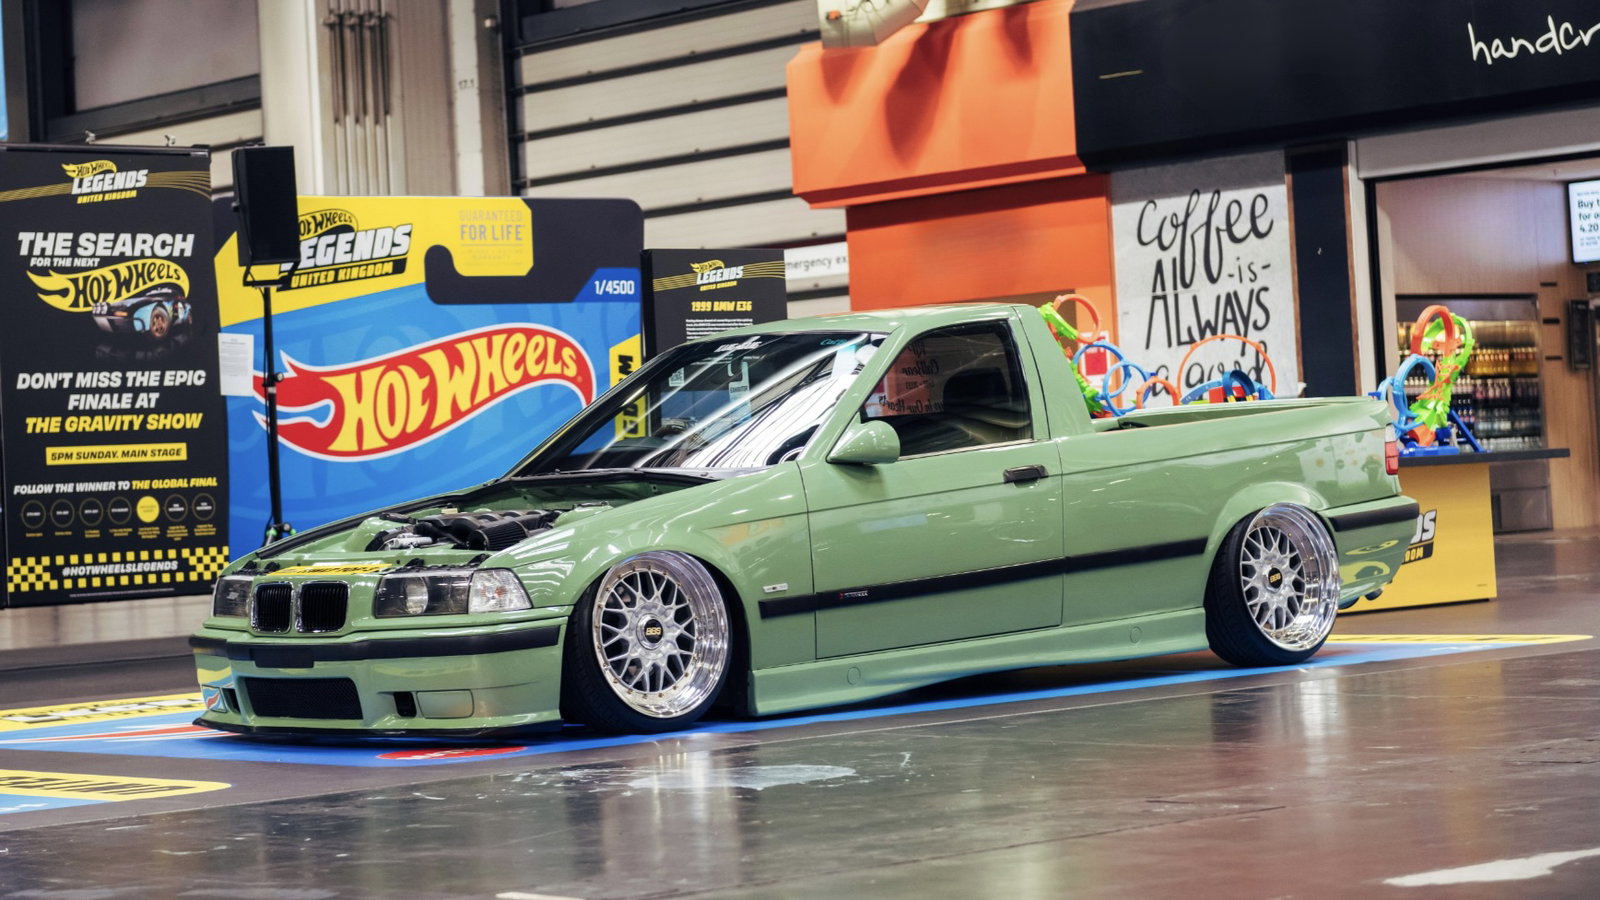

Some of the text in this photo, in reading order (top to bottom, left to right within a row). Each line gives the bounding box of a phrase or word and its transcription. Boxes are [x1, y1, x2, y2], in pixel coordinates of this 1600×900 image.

[72, 169, 148, 194] LEGENDS
[77, 190, 137, 204] UNITED KINGDOM
[1577, 199, 1594, 209] Buy
[459, 209, 523, 222] GUARANTEED
[460, 225, 523, 241] FOR LIFE
[1137, 189, 1274, 289] Coffee
[18, 232, 195, 257] THE SEARCH
[280, 224, 413, 271] EGENDS
[30, 257, 100, 267] FOR THE NEXT
[290, 261, 394, 288] UNITED KINGDOM
[696, 266, 744, 285] LEGENDS
[594, 280, 635, 295] 1/4500
[691, 300, 752, 312] 1999 BMW E36
[16, 370, 206, 390] DON'T MISS THE EPIC
[68, 392, 159, 410] FINALE AT
[25, 413, 203, 433] THE GRAVITY SHOW
[51, 451, 73, 461] 5PM
[121, 448, 148, 459] MAIN
[150, 447, 182, 458] STAGE
[13, 477, 218, 495] FOLLOW THE WINNER TO THE GLOBAL FINAL
[62, 560, 178, 577] #HOTWHEELSLEGENDS
[646, 627, 662, 636] BBS
